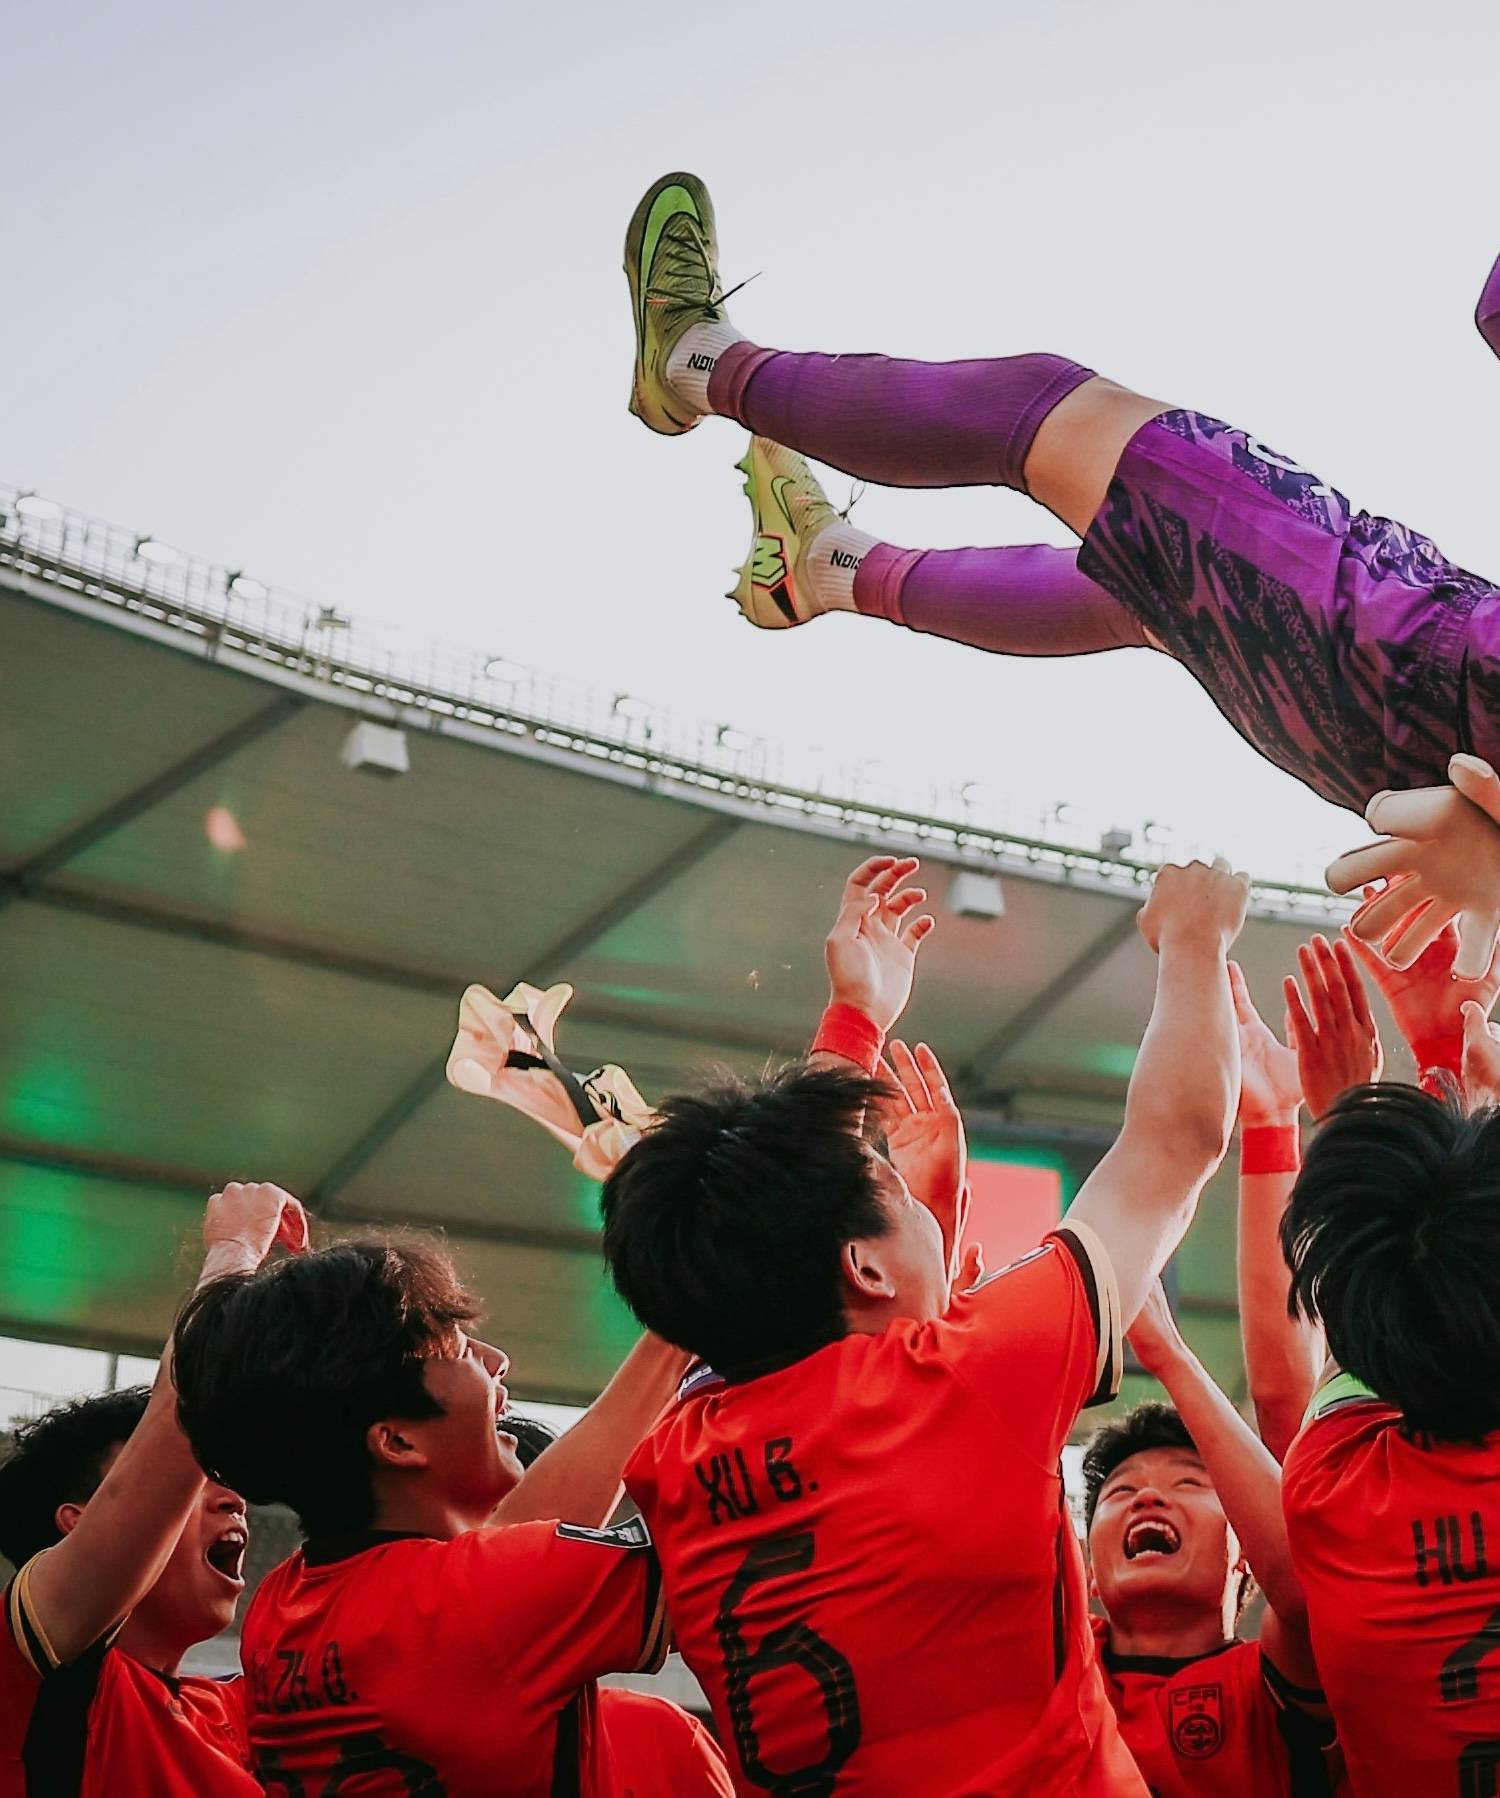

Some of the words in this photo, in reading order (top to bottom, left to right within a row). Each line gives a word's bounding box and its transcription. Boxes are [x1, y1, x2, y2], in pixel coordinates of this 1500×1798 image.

[695, 1447, 757, 1527] XU
[764, 1436, 819, 1498] B.
[1411, 1511, 1488, 1588] HU
[715, 1532, 861, 1798] 6
